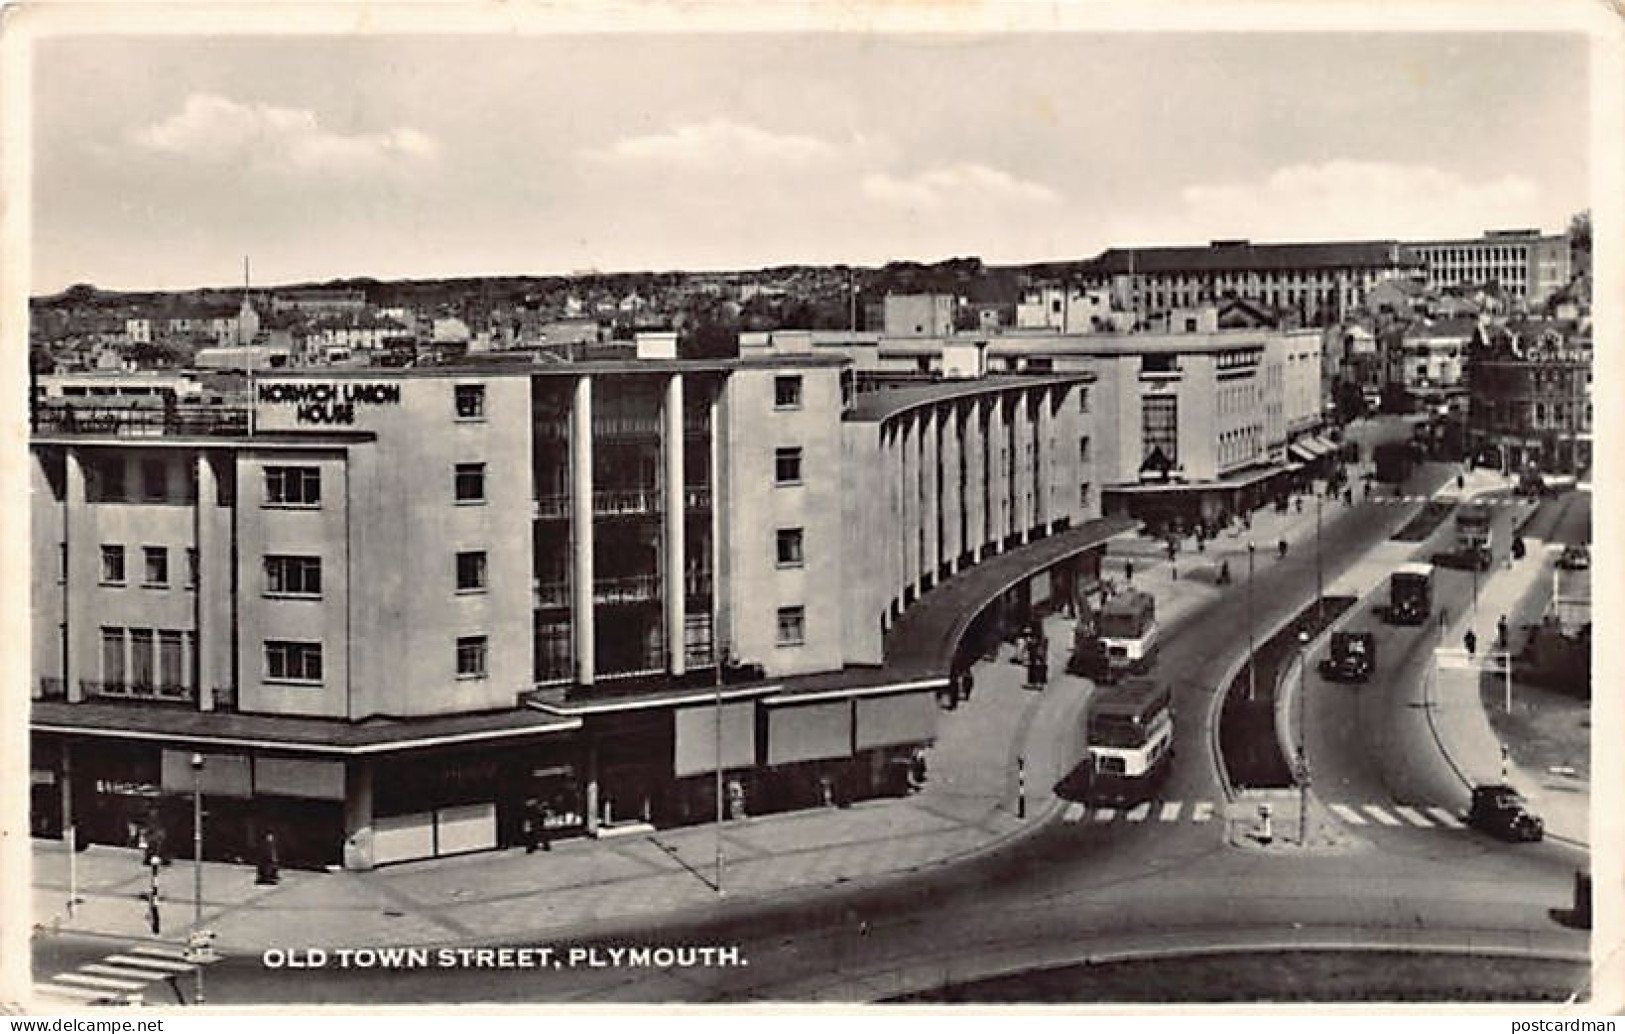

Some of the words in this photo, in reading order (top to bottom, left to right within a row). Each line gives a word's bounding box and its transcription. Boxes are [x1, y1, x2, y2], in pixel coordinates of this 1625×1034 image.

[259, 384, 337, 402] NORWICH
[343, 384, 399, 402] UNION
[297, 404, 354, 424] HOUSE
